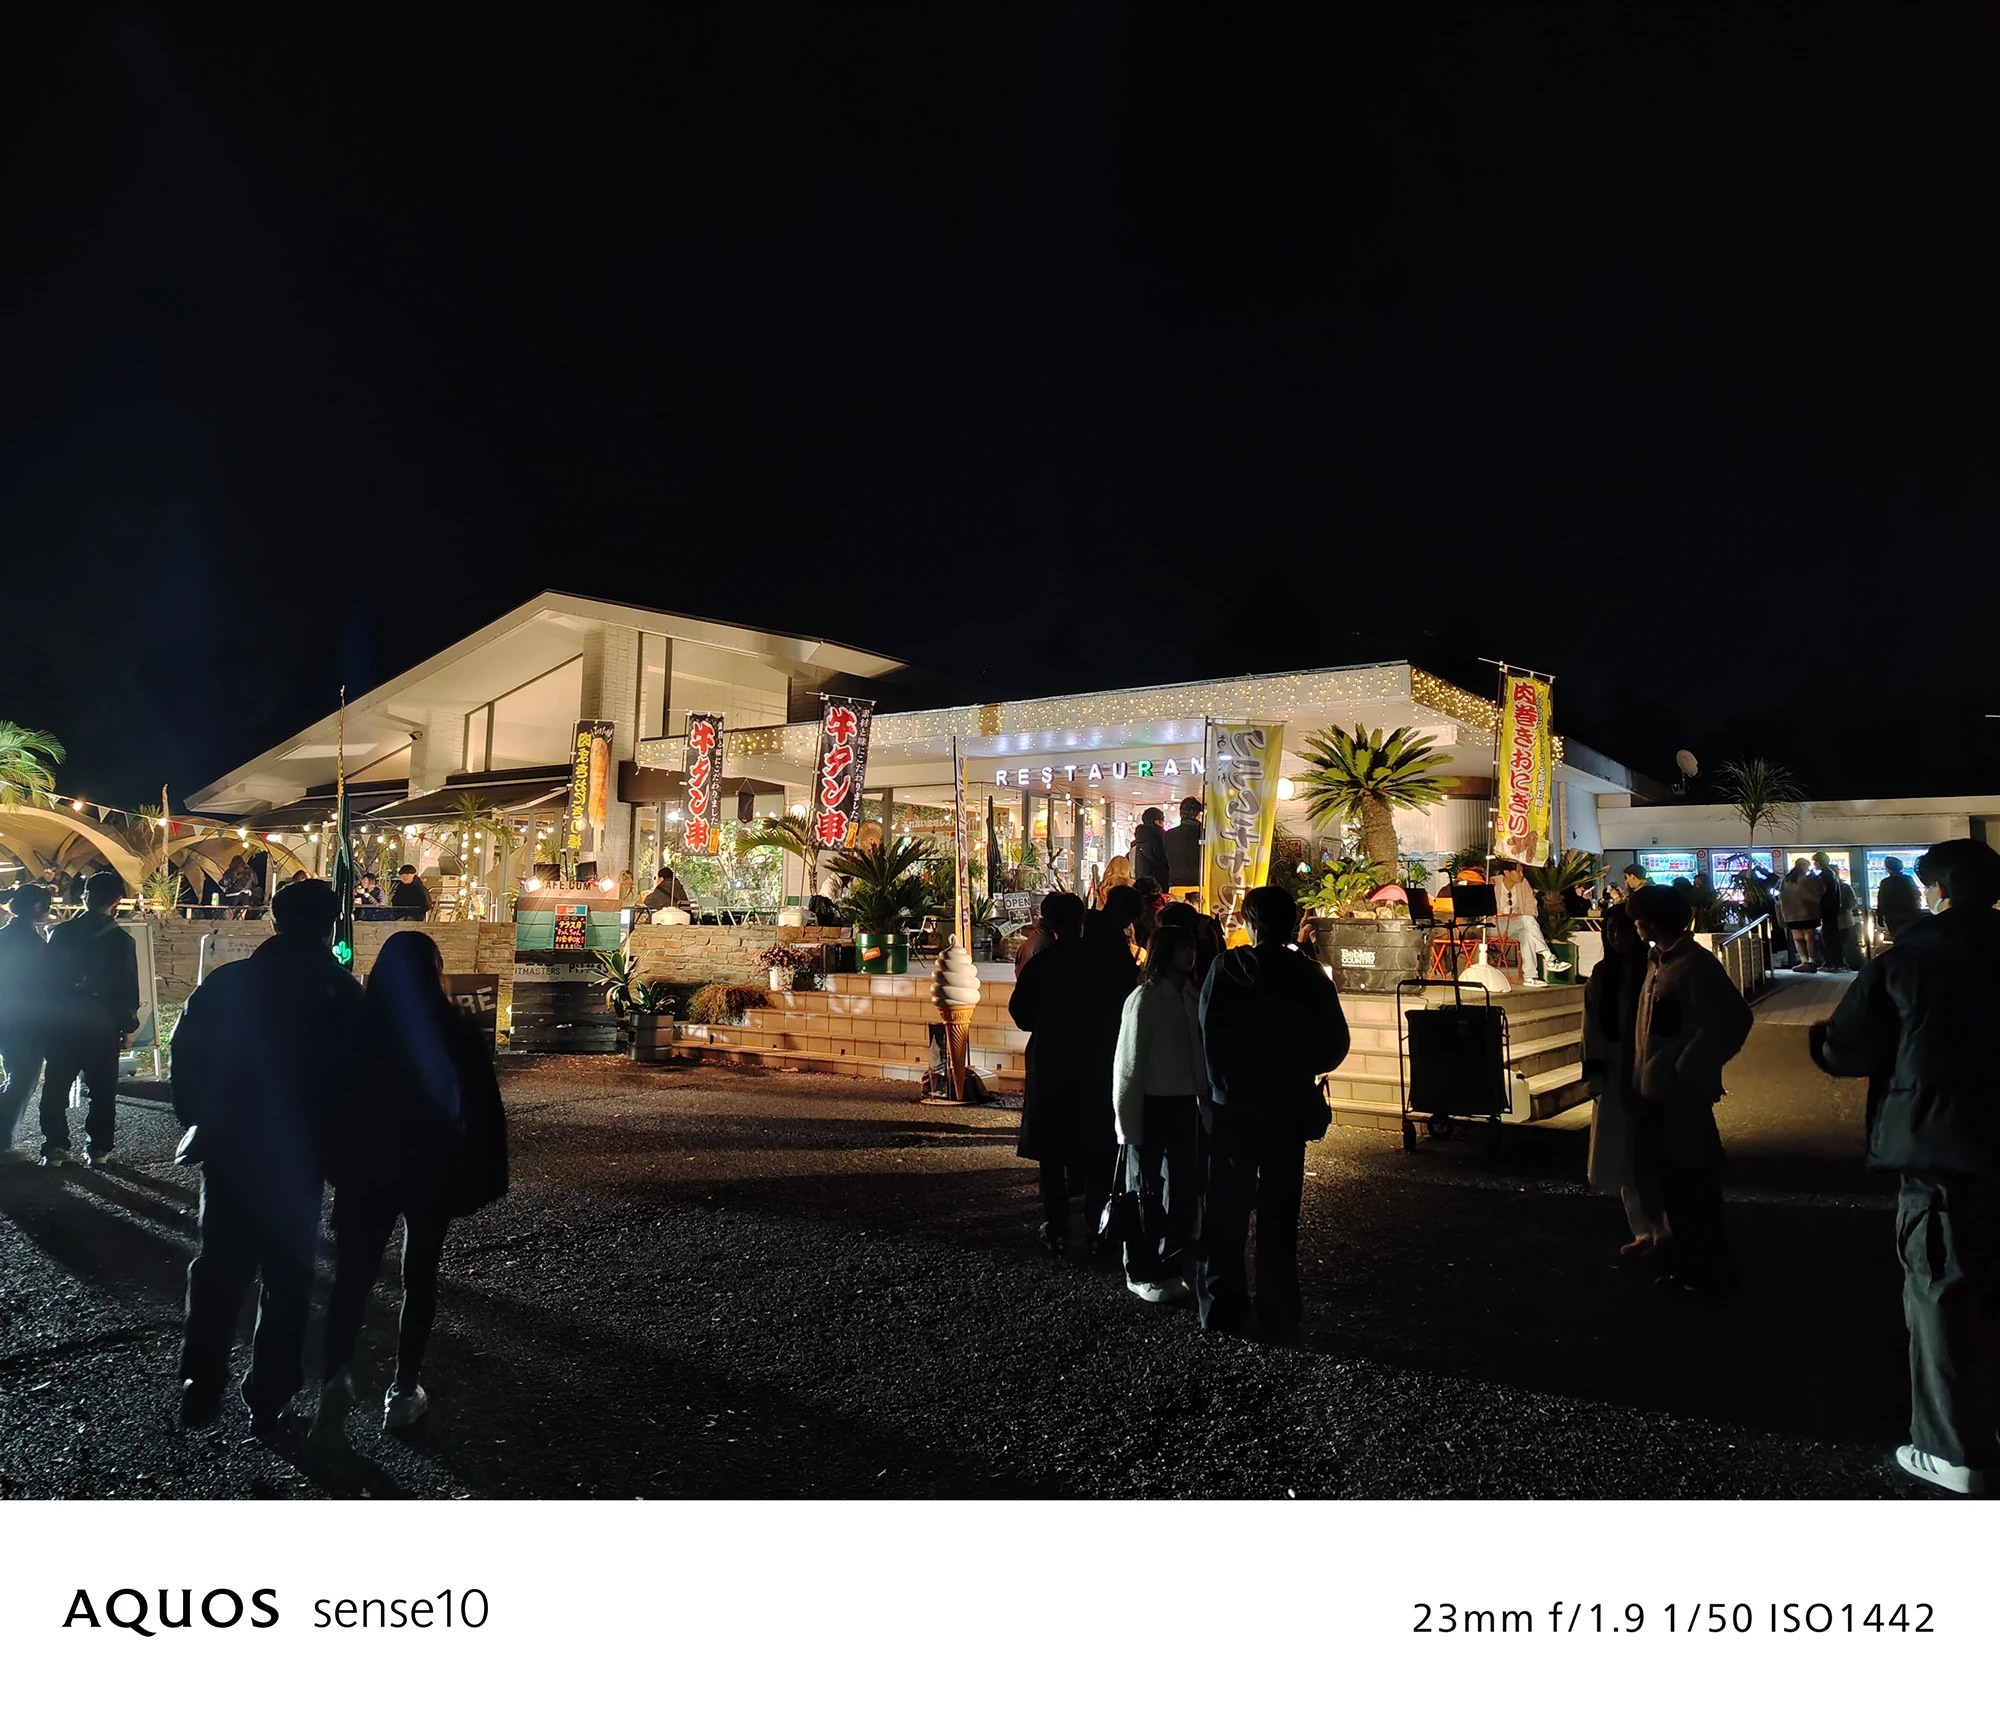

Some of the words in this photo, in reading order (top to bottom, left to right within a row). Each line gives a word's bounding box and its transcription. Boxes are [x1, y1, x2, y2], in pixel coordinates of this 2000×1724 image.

[684, 721, 715, 852] 牛タン串
[815, 706, 857, 847] 牛タン串
[850, 708, 871, 819] 素材と味にこだわりました
[996, 756, 1205, 786] RESTAURAN
[1508, 682, 1537, 838] 肉巻きおにぎり
[1005, 898, 1030, 908] OPEN
